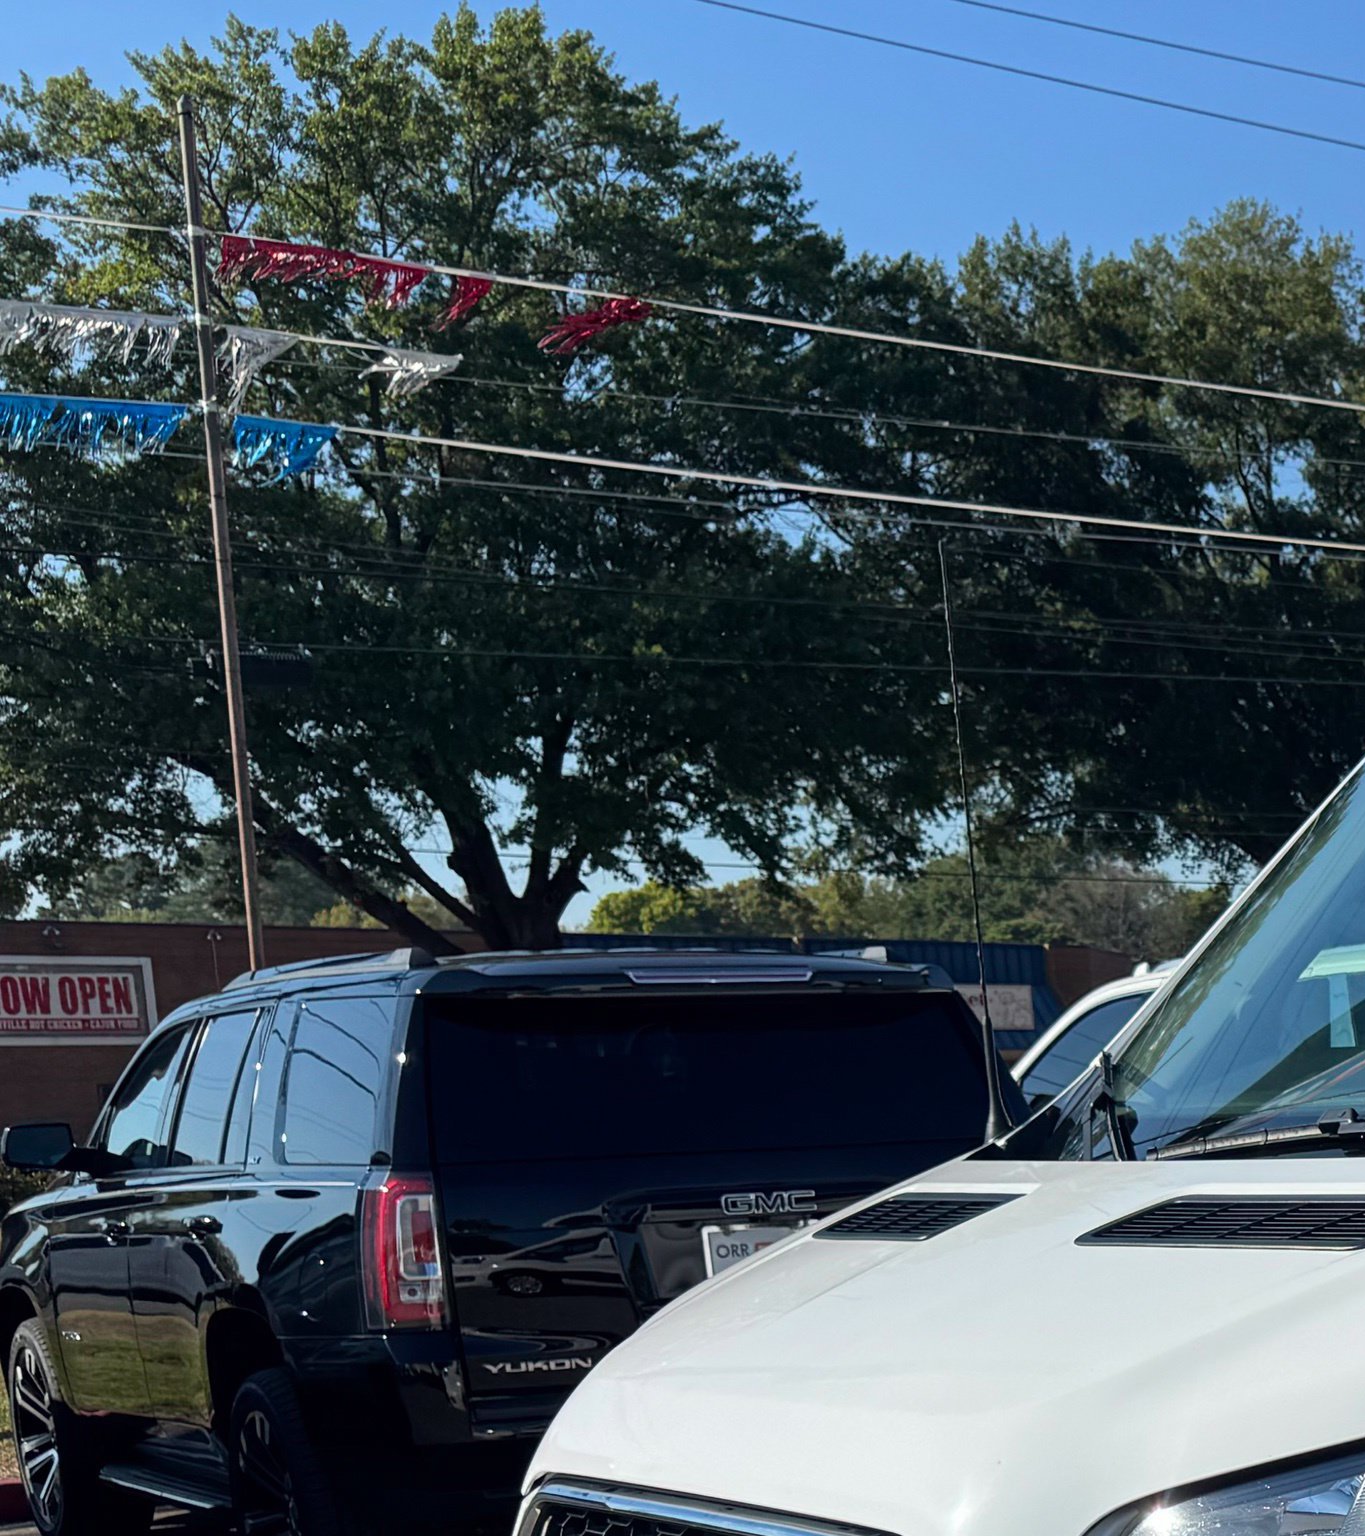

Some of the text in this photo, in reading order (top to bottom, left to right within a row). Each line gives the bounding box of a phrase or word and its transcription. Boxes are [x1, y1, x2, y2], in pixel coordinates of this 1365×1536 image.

[0, 976, 133, 1015] OW OPEN
[721, 1189, 818, 1215] GMC
[716, 1243, 750, 1259] ORR
[482, 1357, 593, 1374] YUKON
